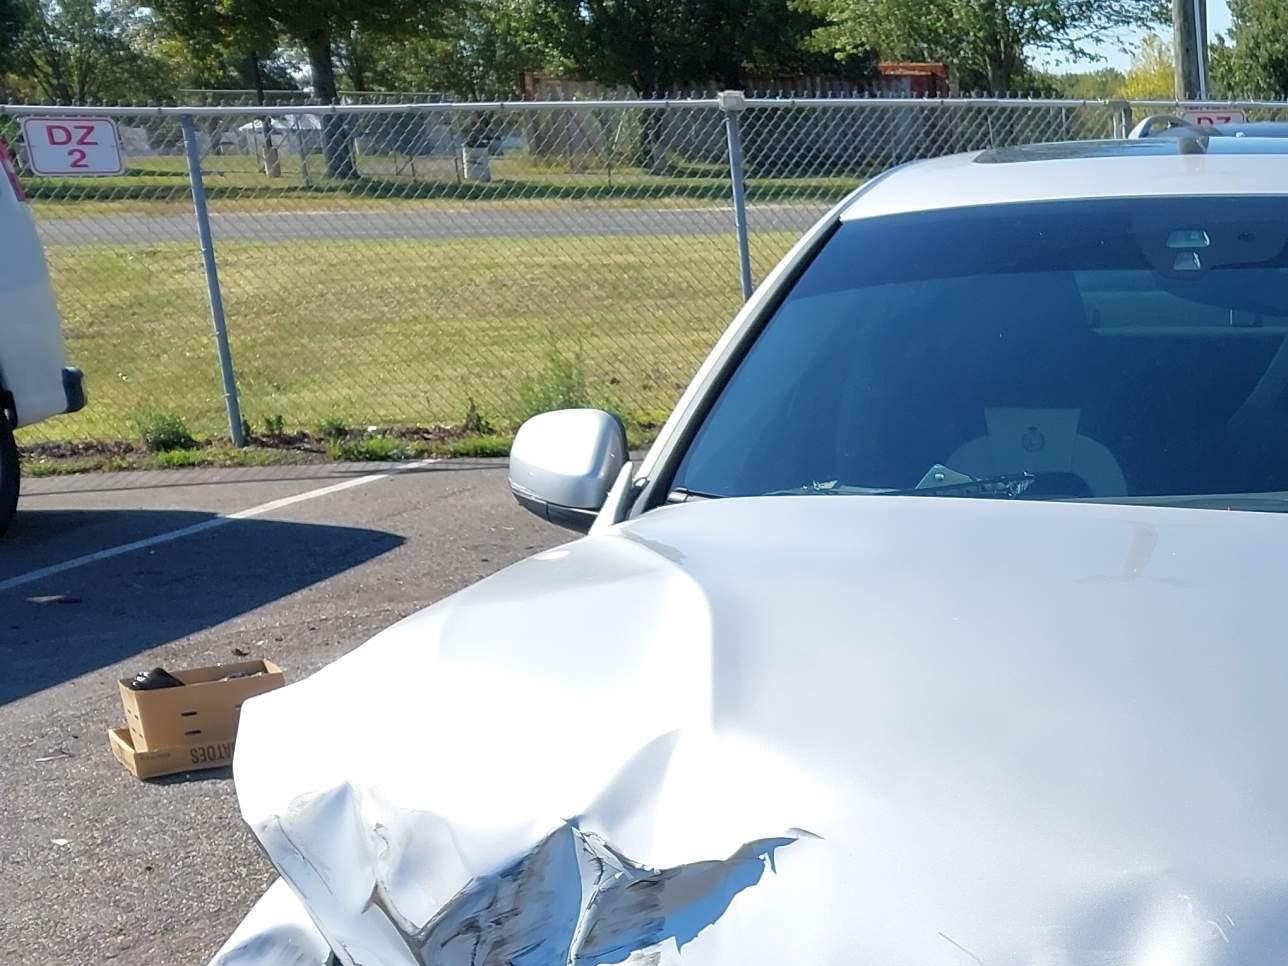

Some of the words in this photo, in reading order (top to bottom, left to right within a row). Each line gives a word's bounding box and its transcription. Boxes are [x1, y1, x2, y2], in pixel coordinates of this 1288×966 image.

[46, 125, 98, 146] DZ
[67, 149, 89, 168] 2
[190, 743, 233, 764] ATOES
